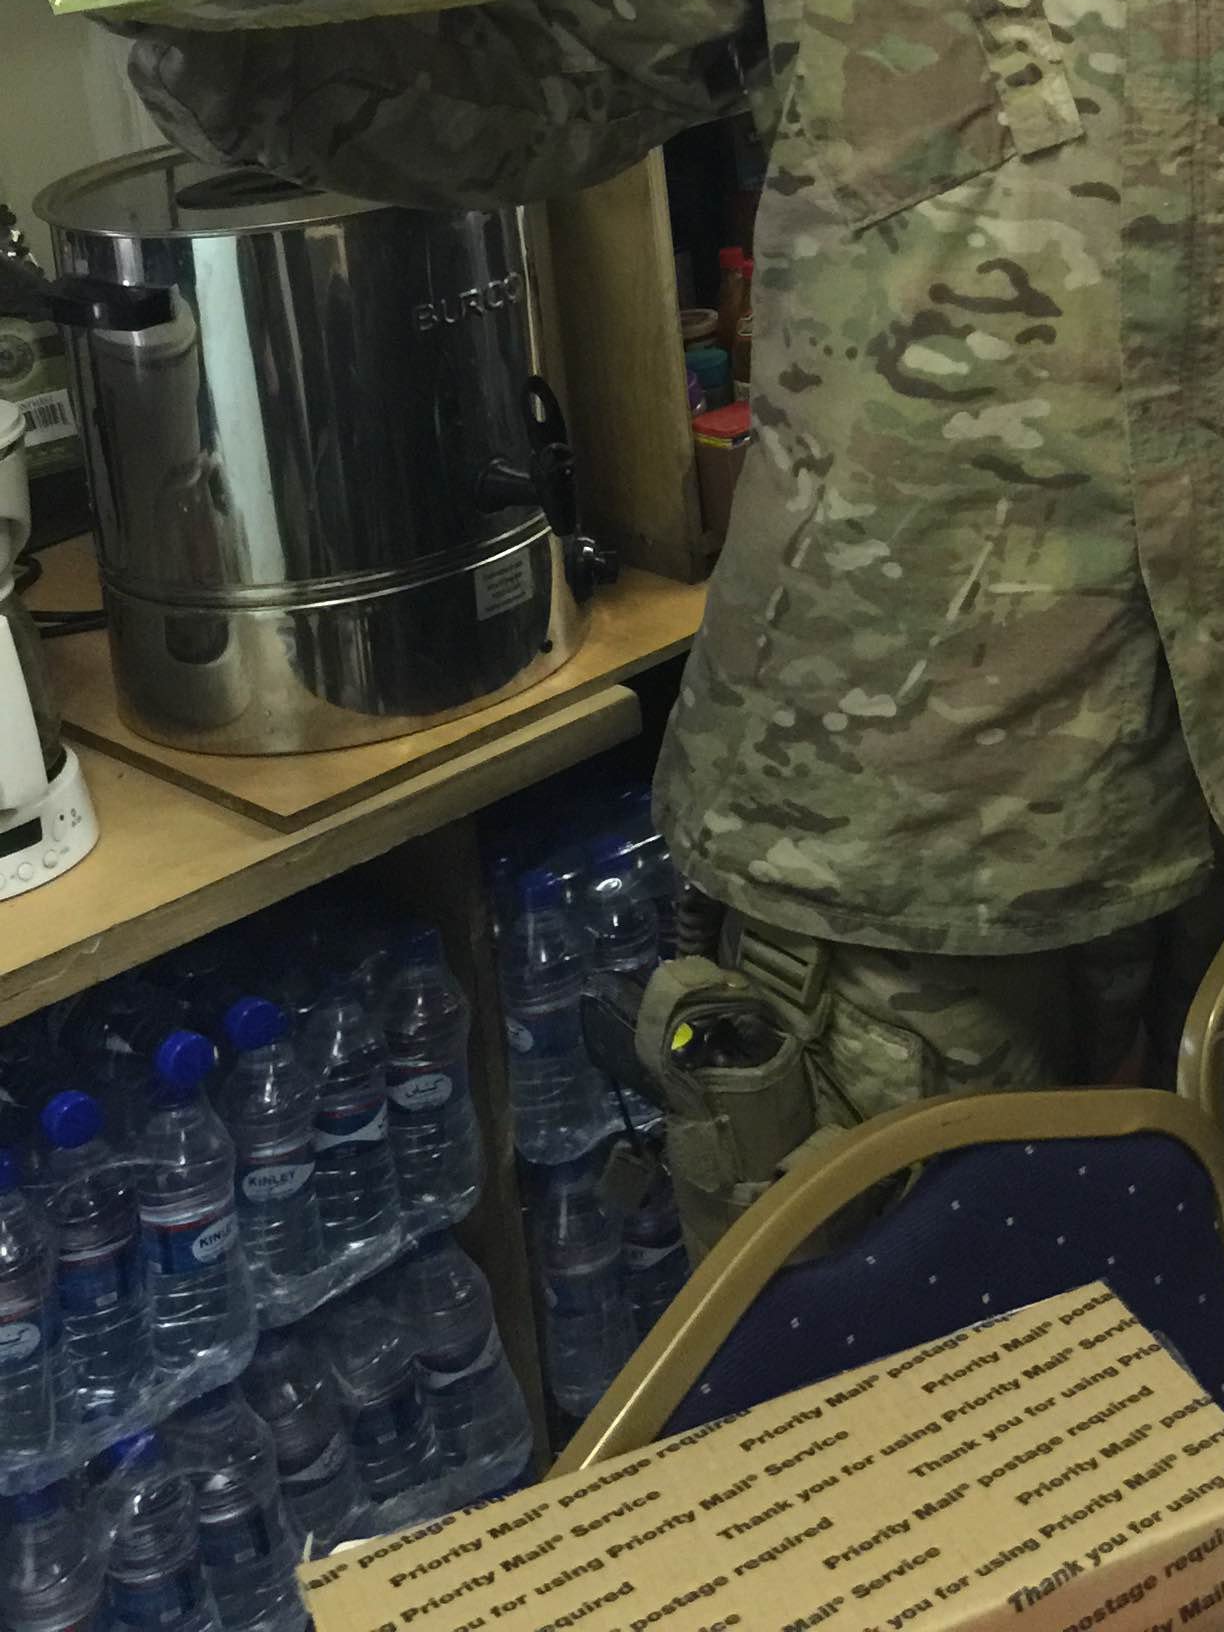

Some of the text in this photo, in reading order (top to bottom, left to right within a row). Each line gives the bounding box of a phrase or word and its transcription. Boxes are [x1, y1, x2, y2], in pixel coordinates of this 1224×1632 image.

[413, 271, 521, 332] BURCO
[248, 1169, 297, 1189] KINLEY
[738, 1404, 823, 1453] Priority
[886, 1332, 970, 1379] postage
[908, 1364, 1120, 1480] Thank you for using
[714, 1496, 795, 1541] Thank
[795, 1472, 840, 1504] you
[840, 1452, 876, 1477] for
[880, 1419, 942, 1457] using
[942, 1377, 1021, 1423] Priority
[821, 1516, 911, 1570] Priority
[976, 1434, 1064, 1488] postage
[1065, 1384, 1156, 1439] required
[387, 1535, 484, 1590] Priority
[558, 1456, 652, 1509] postage
[1007, 1558, 1085, 1614] Thank
[1084, 1532, 1130, 1567] you
[1127, 1509, 1164, 1534] for
